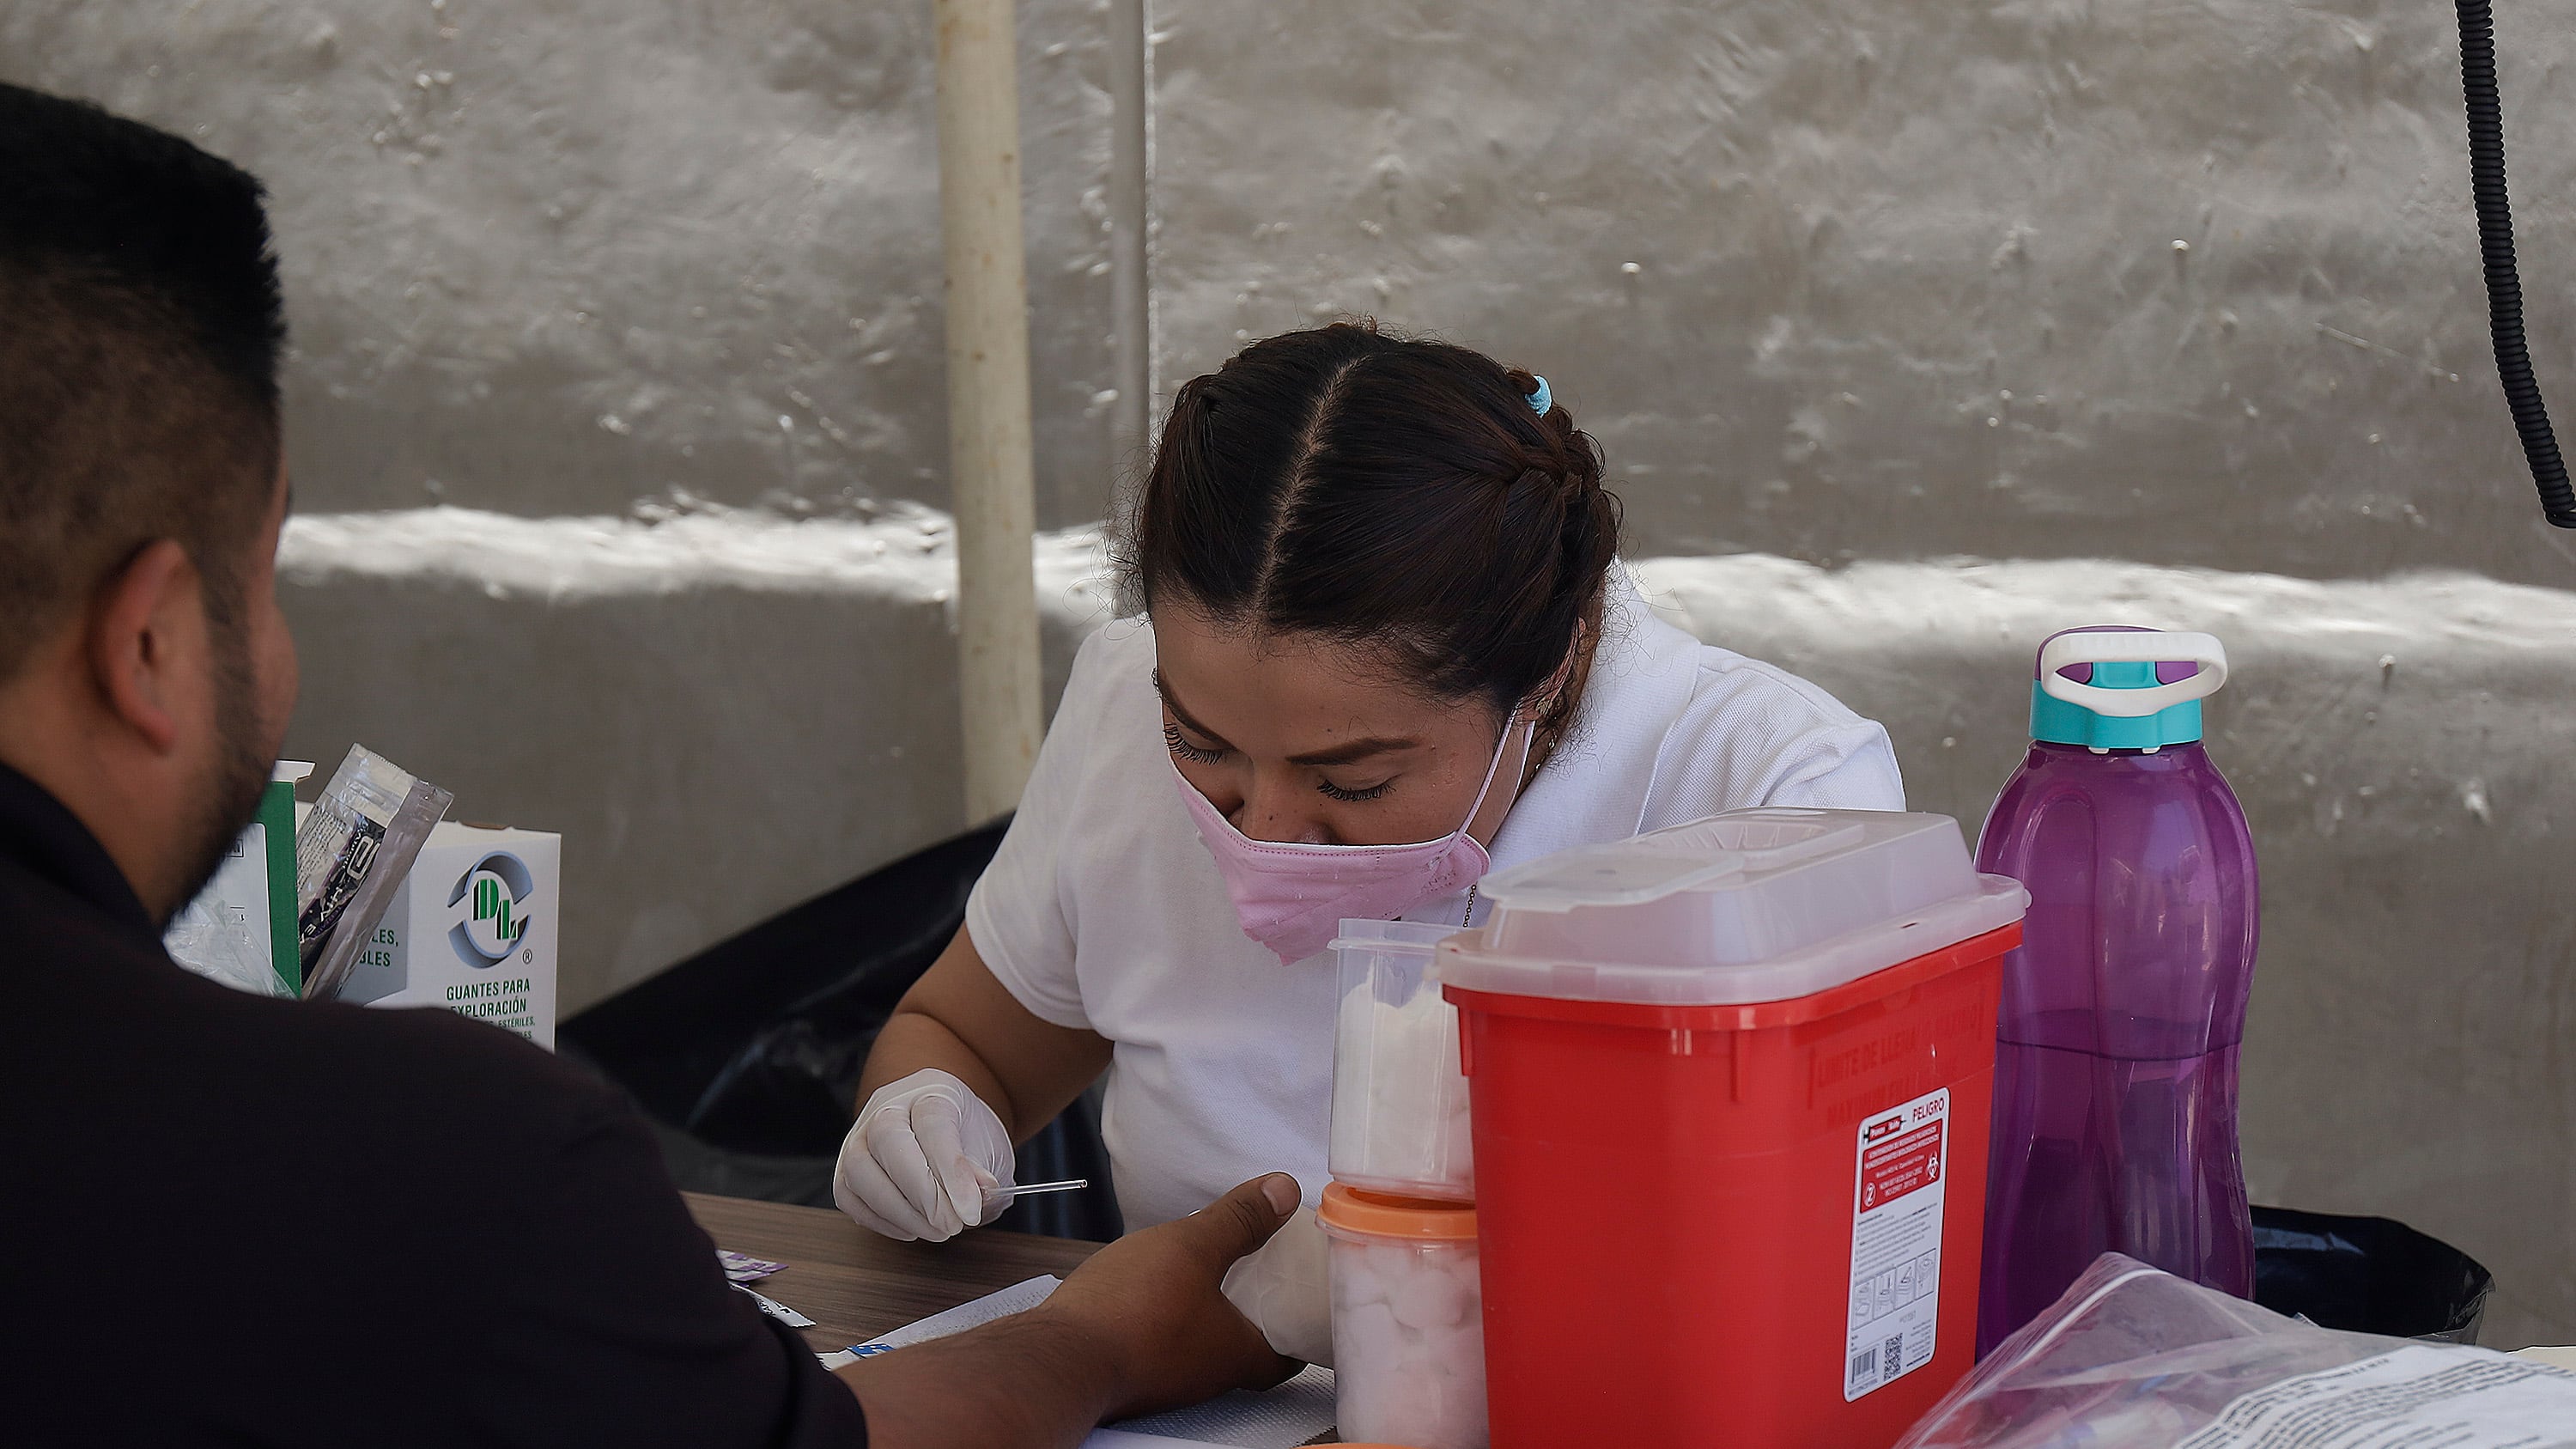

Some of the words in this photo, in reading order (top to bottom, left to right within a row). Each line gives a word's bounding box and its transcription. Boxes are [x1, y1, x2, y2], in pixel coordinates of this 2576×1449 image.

[320, 886, 343, 922] HIV
[472, 879, 518, 941] DL
[447, 982, 499, 1001] GUANTES
[502, 977, 530, 995] PARA
[1912, 1097, 1945, 1123] PELIGRO
